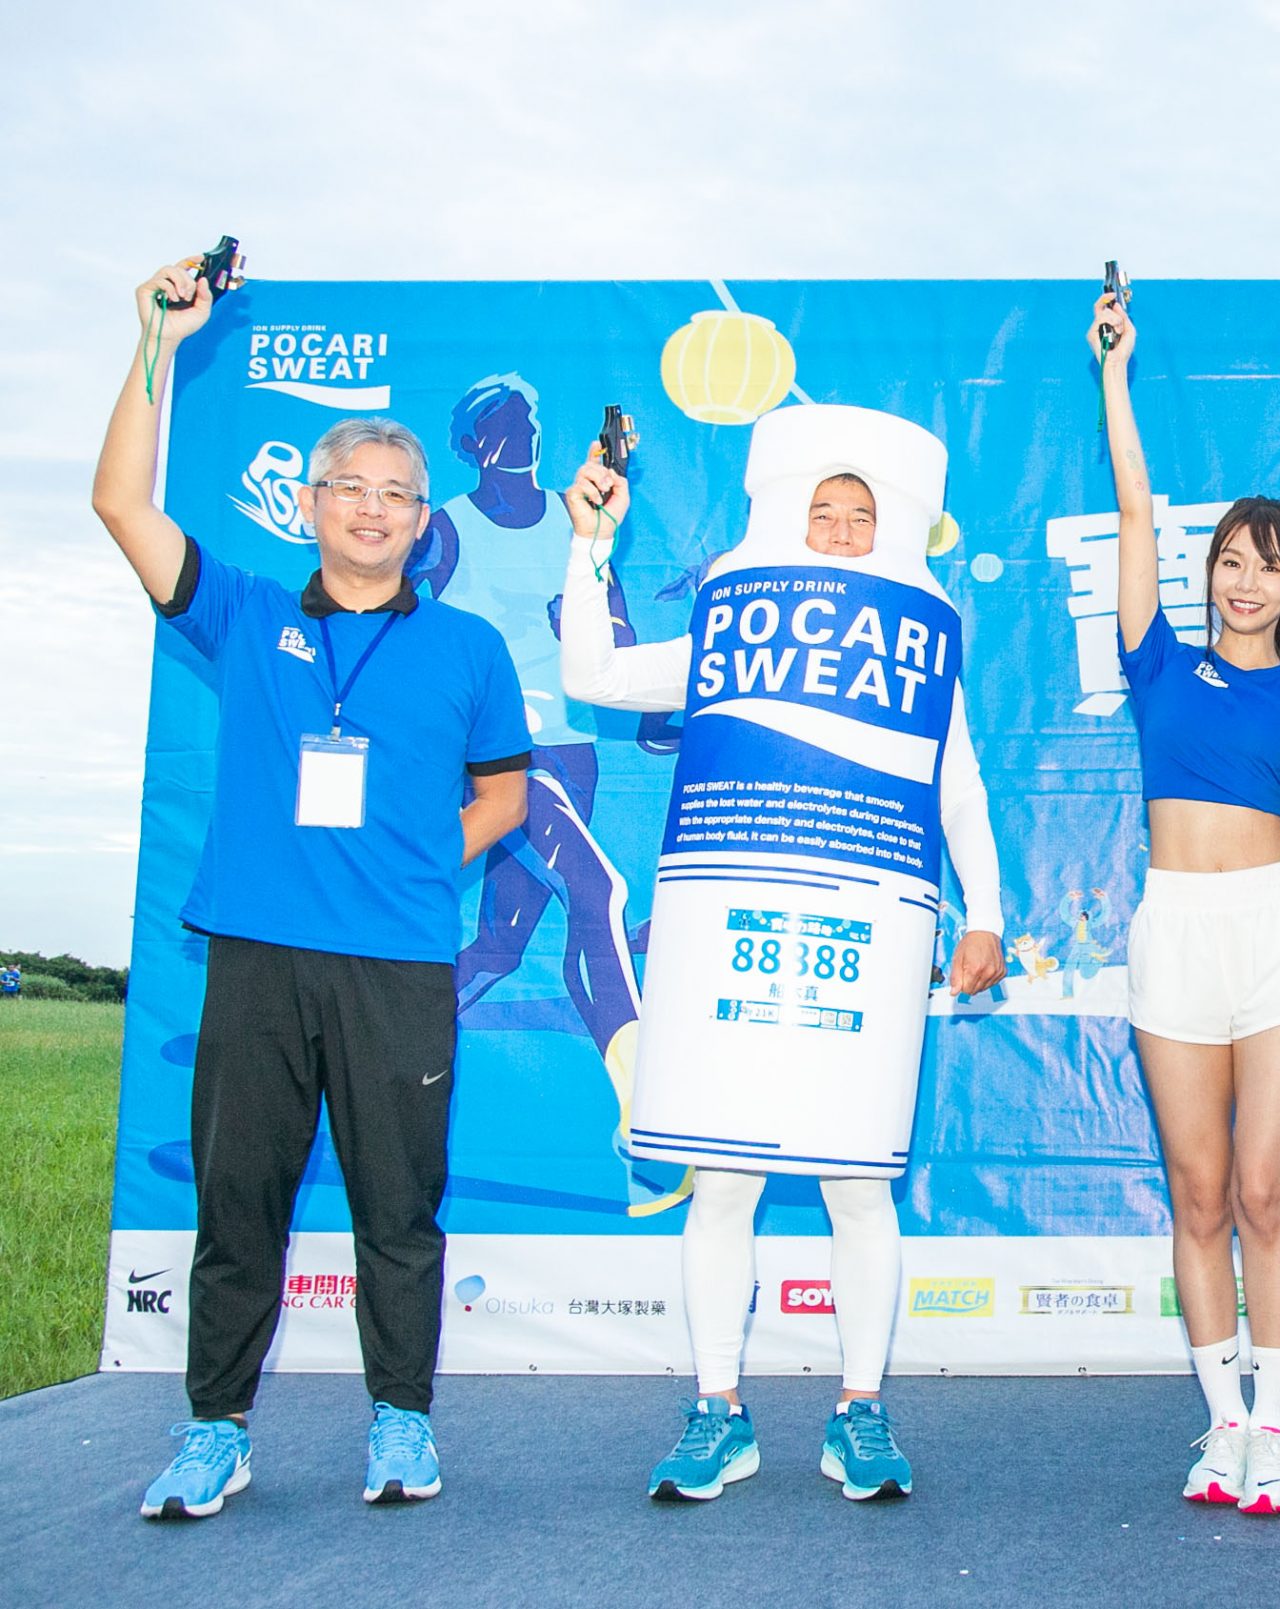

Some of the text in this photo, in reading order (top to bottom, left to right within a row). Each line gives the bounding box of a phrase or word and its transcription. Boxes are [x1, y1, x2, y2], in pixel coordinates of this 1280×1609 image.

[250, 333, 388, 356] POCARI
[248, 357, 375, 380] SWEAT
[711, 580, 848, 601] ION SUPPLY DRINK
[703, 598, 948, 677] POCARI
[697, 648, 927, 715] SWEAT
[683, 781, 904, 812] POCARI SWEAT is a healthy beverage that smoothly
[706, 798, 718, 807] the
[719, 798, 736, 807] lost
[736, 799, 764, 807] water
[765, 799, 785, 809] and
[787, 800, 848, 816] electrolytes
[849, 809, 879, 824] during
[692, 816, 703, 824] the
[704, 814, 752, 826] appropriate
[754, 814, 792, 827] density
[793, 818, 814, 828] and
[876, 831, 898, 843] close
[899, 837, 907, 846] to
[908, 838, 921, 851] that
[683, 832, 704, 841] human
[705, 831, 725, 842] body
[751, 831, 759, 841] it
[760, 833, 779, 842] can
[780, 832, 795, 843] be
[796, 835, 827, 849] easily
[828, 840, 874, 855] absorbed
[875, 847, 892, 859] into
[893, 852, 906, 862] the
[126, 1289, 172, 1313] NRC
[309, 1295, 344, 1309] CAR
[485, 1297, 555, 1315] Otsuka
[568, 1297, 666, 1316] 台灣大塚製藥
[787, 1287, 834, 1307] SOY
[912, 1290, 990, 1307] MATCH
